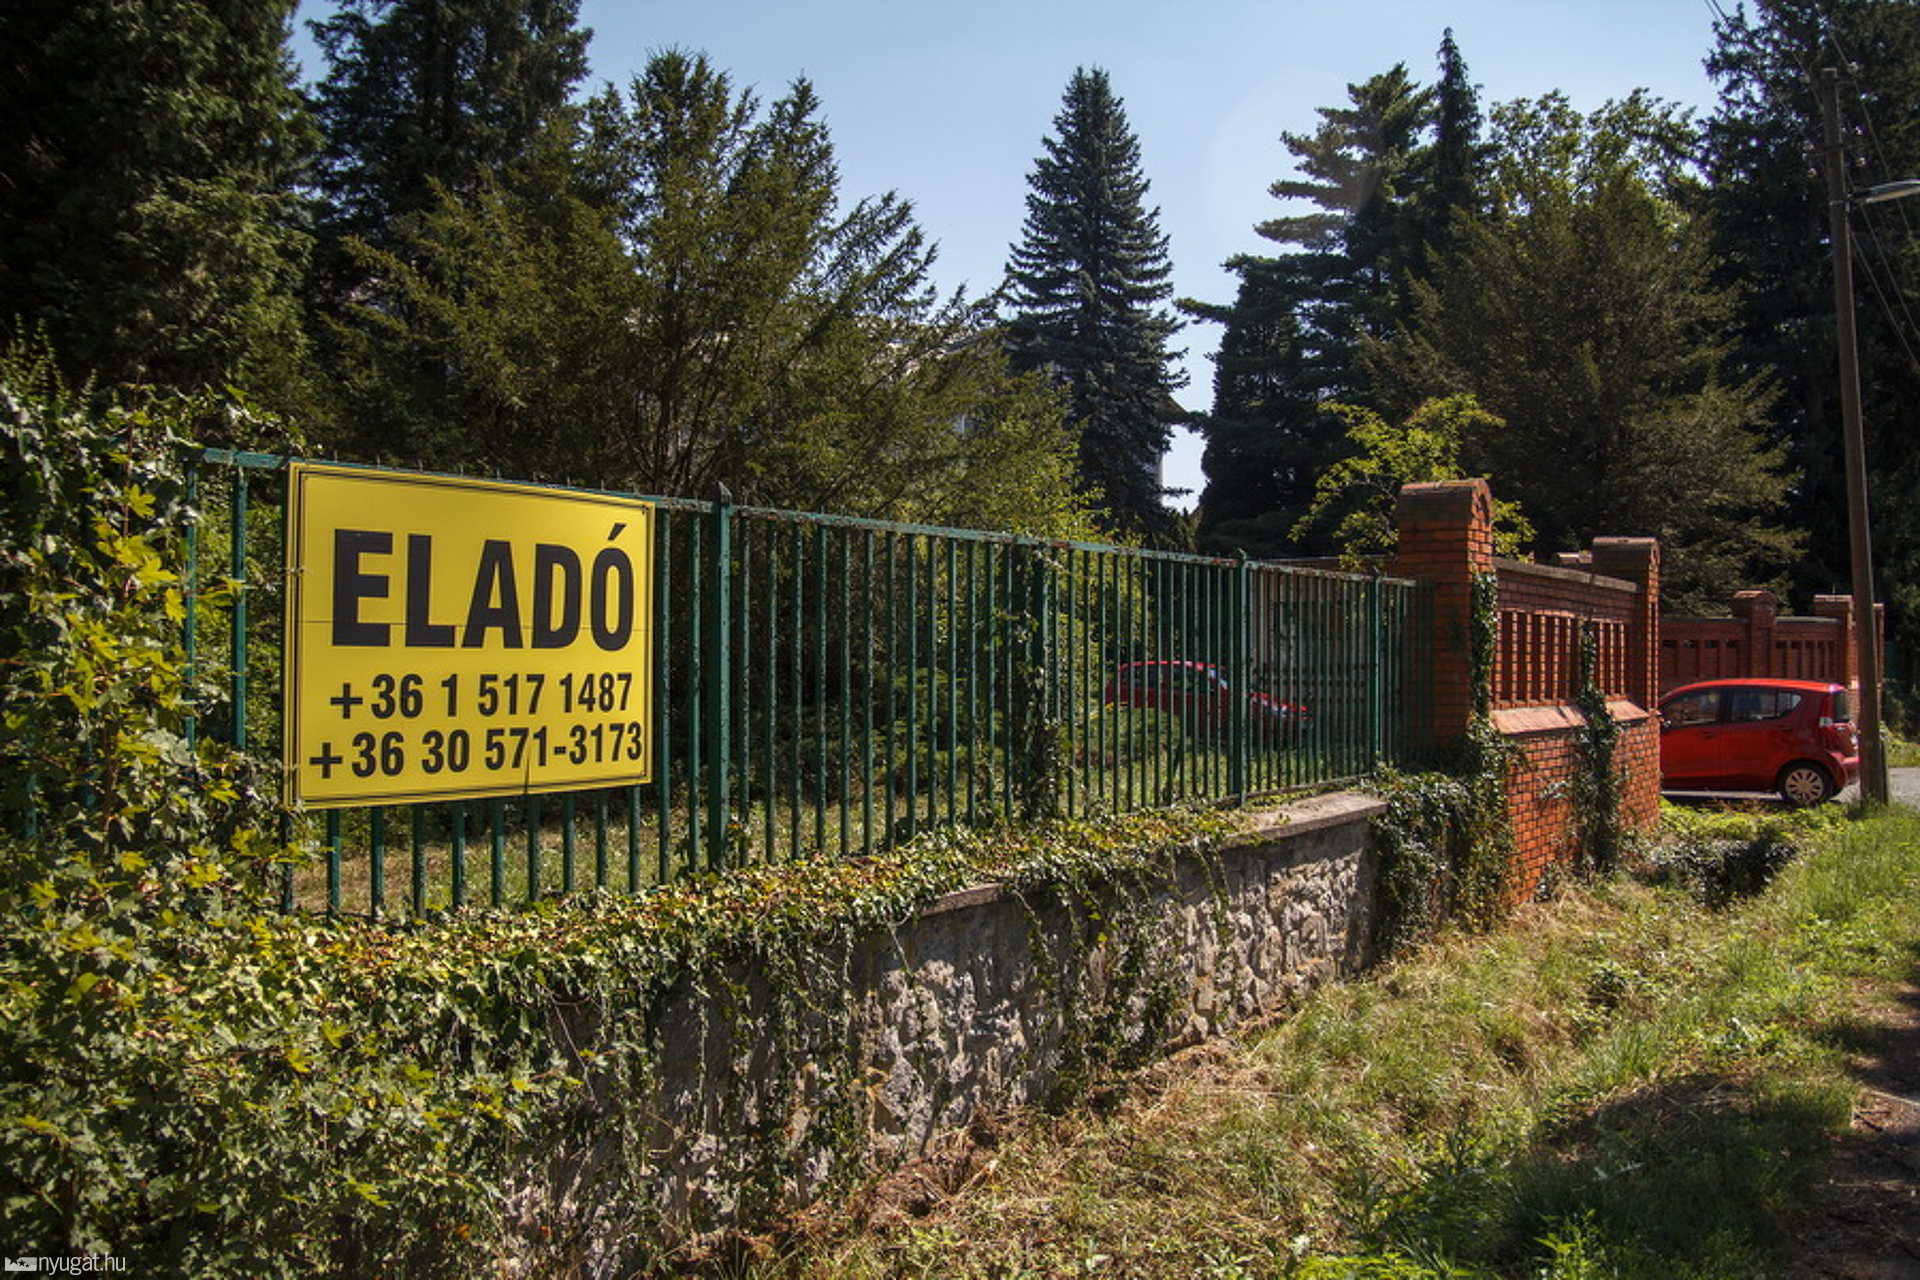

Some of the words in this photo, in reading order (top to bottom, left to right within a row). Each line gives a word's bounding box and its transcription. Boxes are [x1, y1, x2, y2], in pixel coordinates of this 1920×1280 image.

[332, 523, 635, 652] ELADÓ
[330, 673, 423, 720] +36
[441, 673, 458, 717] 1
[477, 673, 545, 717] 517
[559, 672, 632, 713] 1487
[309, 731, 405, 779] +36
[421, 729, 470, 774] 30
[484, 721, 642, 771] 571-3173
